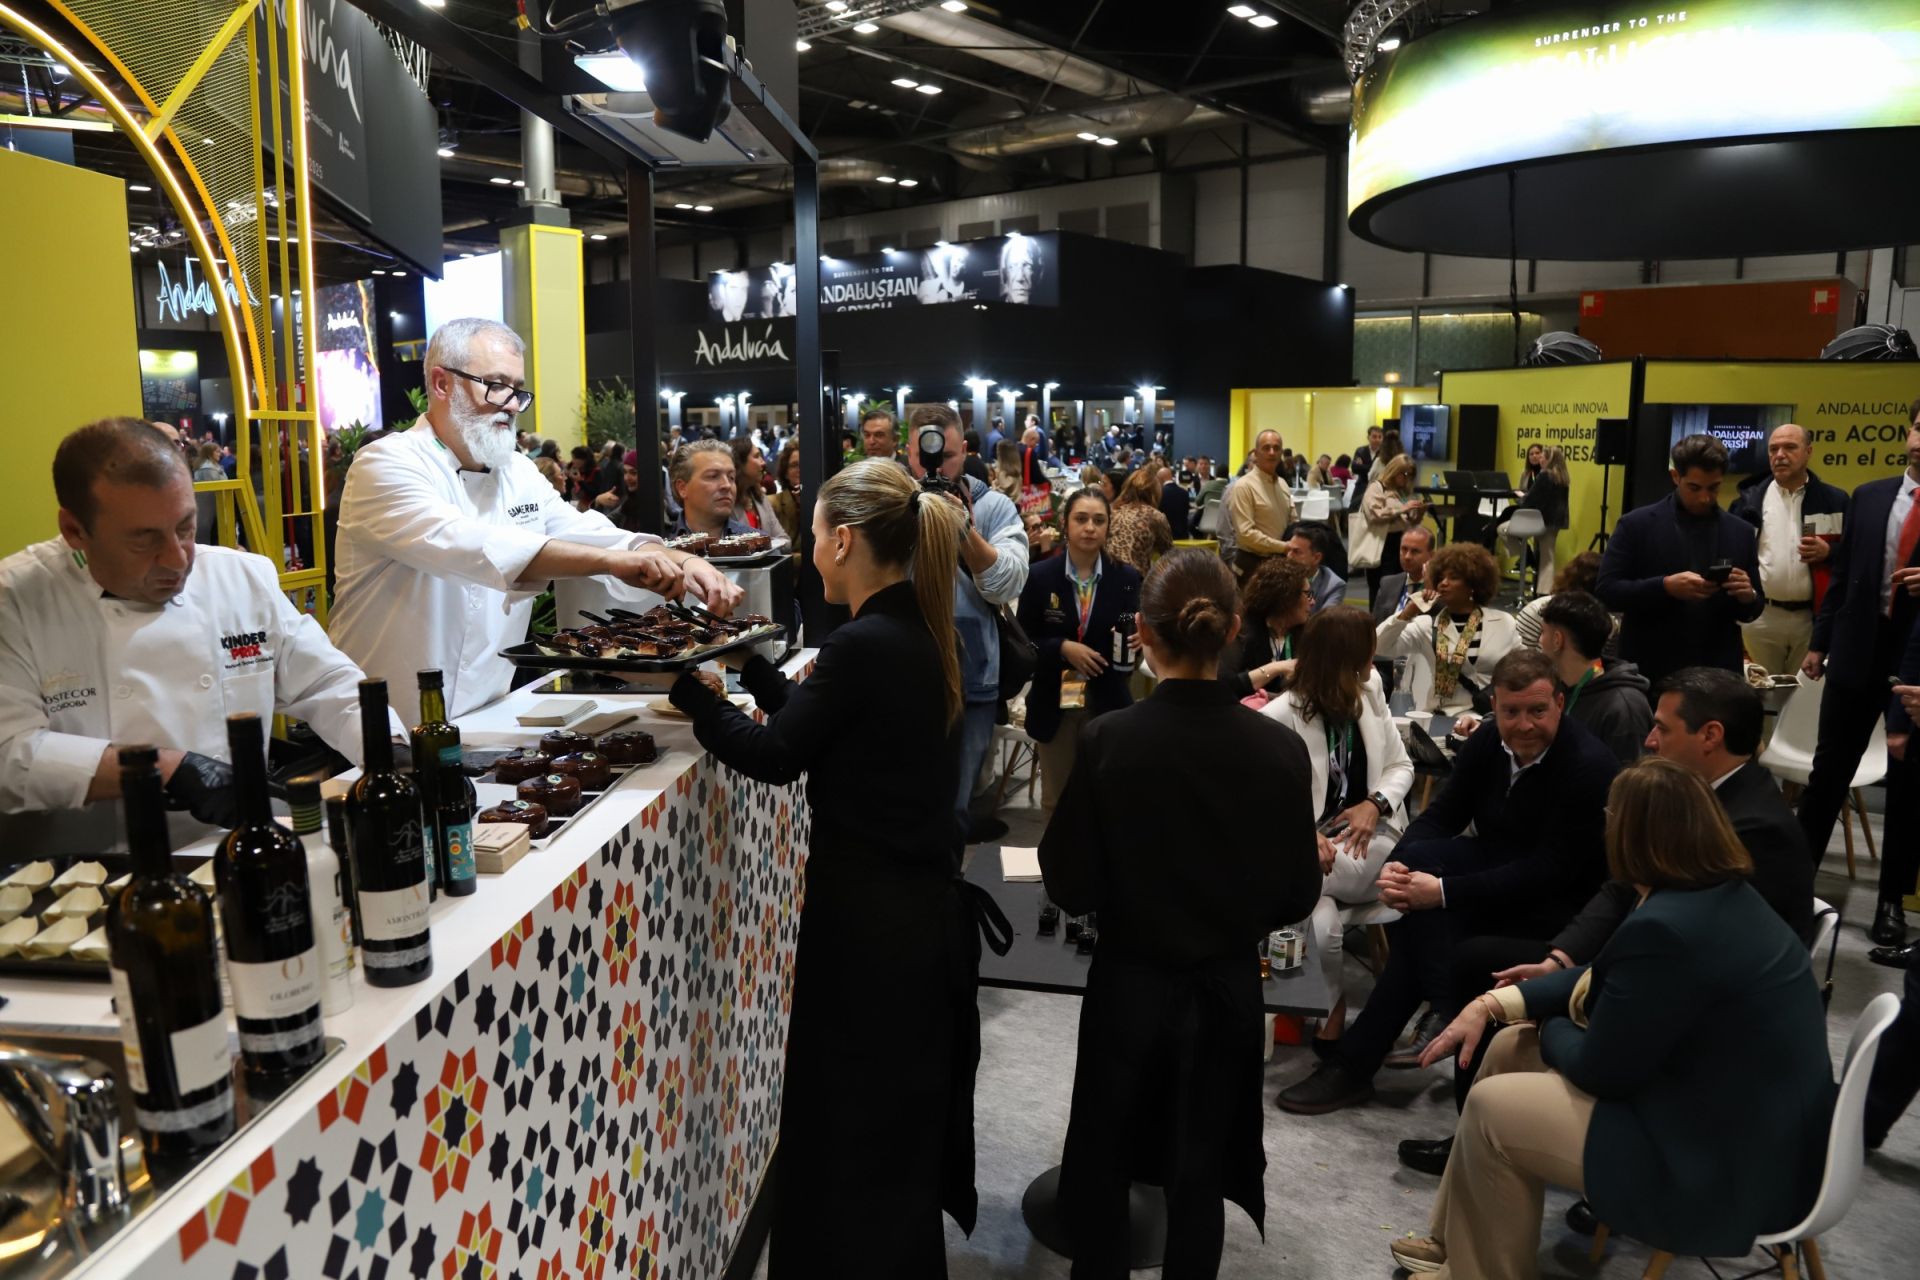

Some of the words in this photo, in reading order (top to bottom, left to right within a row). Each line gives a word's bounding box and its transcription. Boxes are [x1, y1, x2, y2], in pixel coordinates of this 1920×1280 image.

[1534, 22, 1621, 48] SURRENDER
[1629, 17, 1648, 30] TO
[1656, 11, 1687, 25] THE
[820, 276, 919, 304] NDALUSIAN
[295, 301, 306, 384] USINESS
[695, 323, 790, 366] Andalucía
[1520, 403, 1569, 415] ANDALUCIA
[1573, 402, 1609, 414] INNOVA
[1816, 402, 1909, 415] ANDALUCIA
[1516, 427, 1541, 441] para
[1808, 429, 1836, 442] ara
[1845, 425, 1908, 442] ACOM
[1517, 444, 1526, 459] la
[1722, 440, 1748, 449] RUSH
[1823, 453, 1848, 466] en
[1857, 447, 1876, 466] el
[1884, 453, 1908, 466] ca
[220, 631, 267, 650] KINDER
[230, 643, 262, 660] PRIX
[44, 687, 97, 705] OSTECOR
